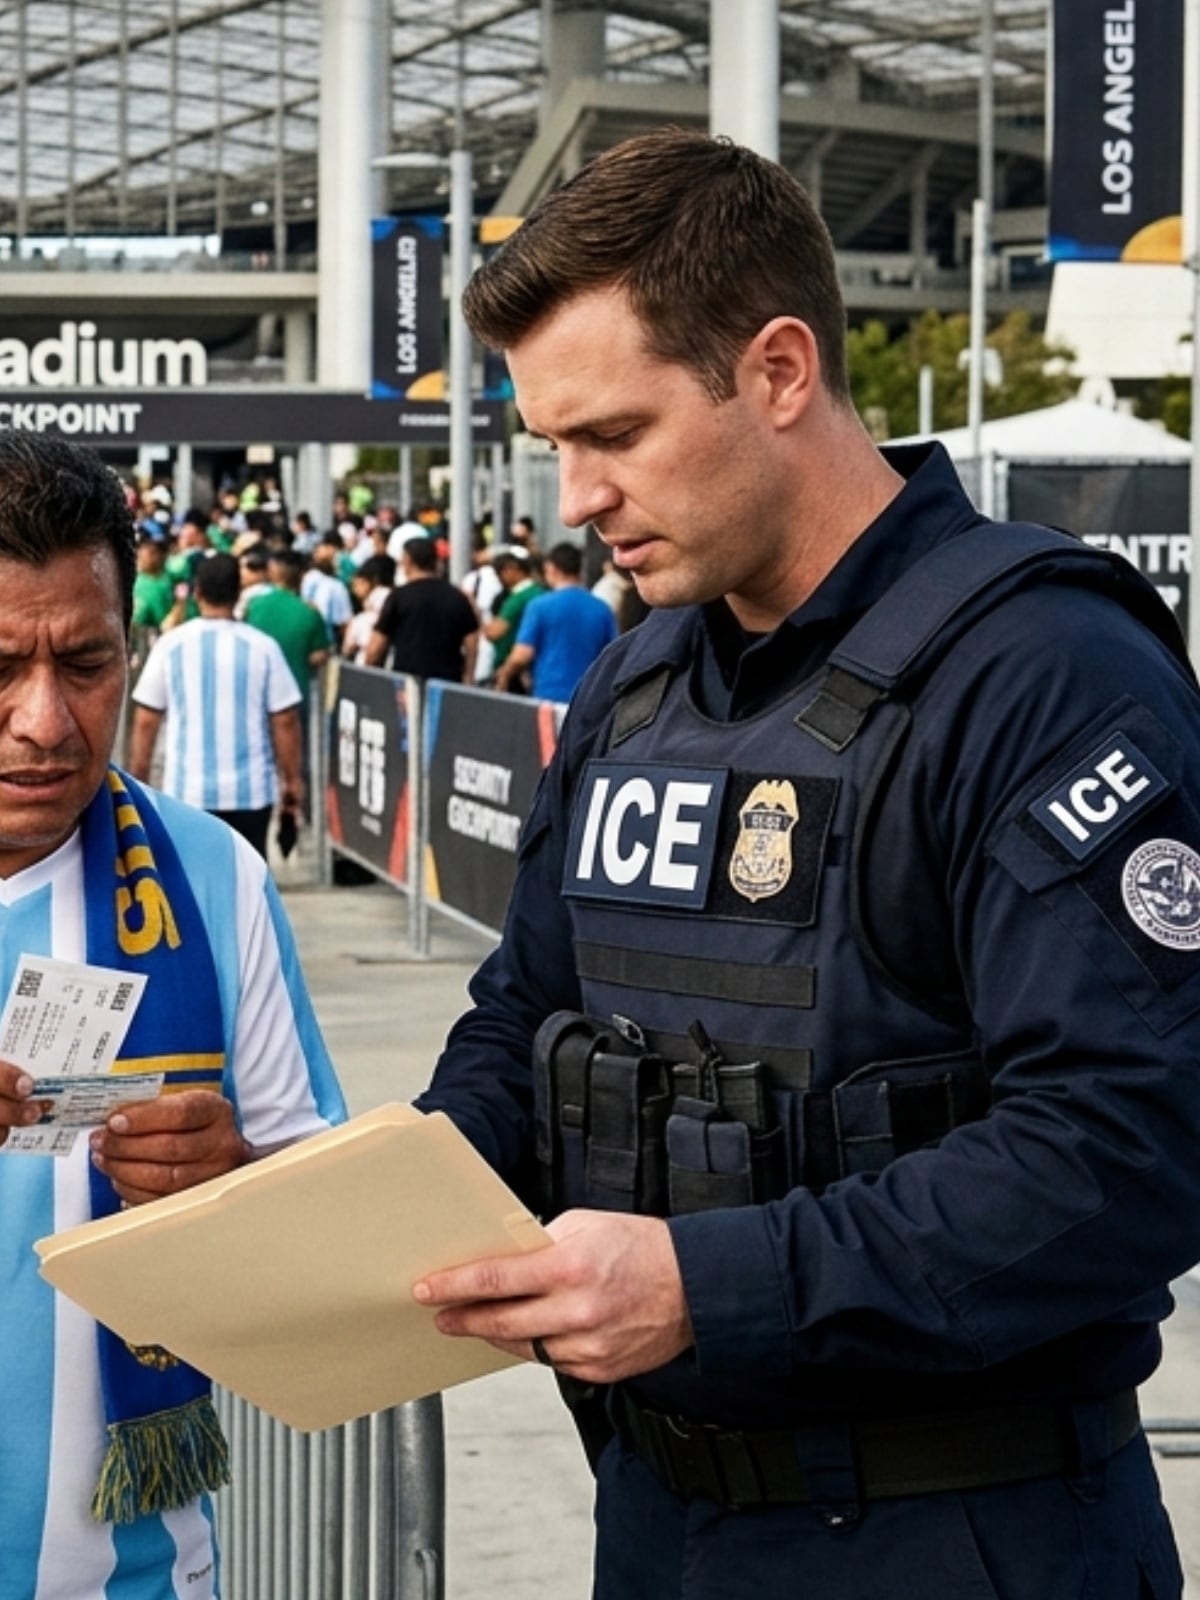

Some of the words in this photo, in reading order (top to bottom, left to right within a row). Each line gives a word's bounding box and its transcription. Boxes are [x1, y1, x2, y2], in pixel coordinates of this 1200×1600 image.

[1101, 139, 1133, 214] LOS
[576, 777, 712, 891] ICE
[1048, 750, 1151, 842] ICE
